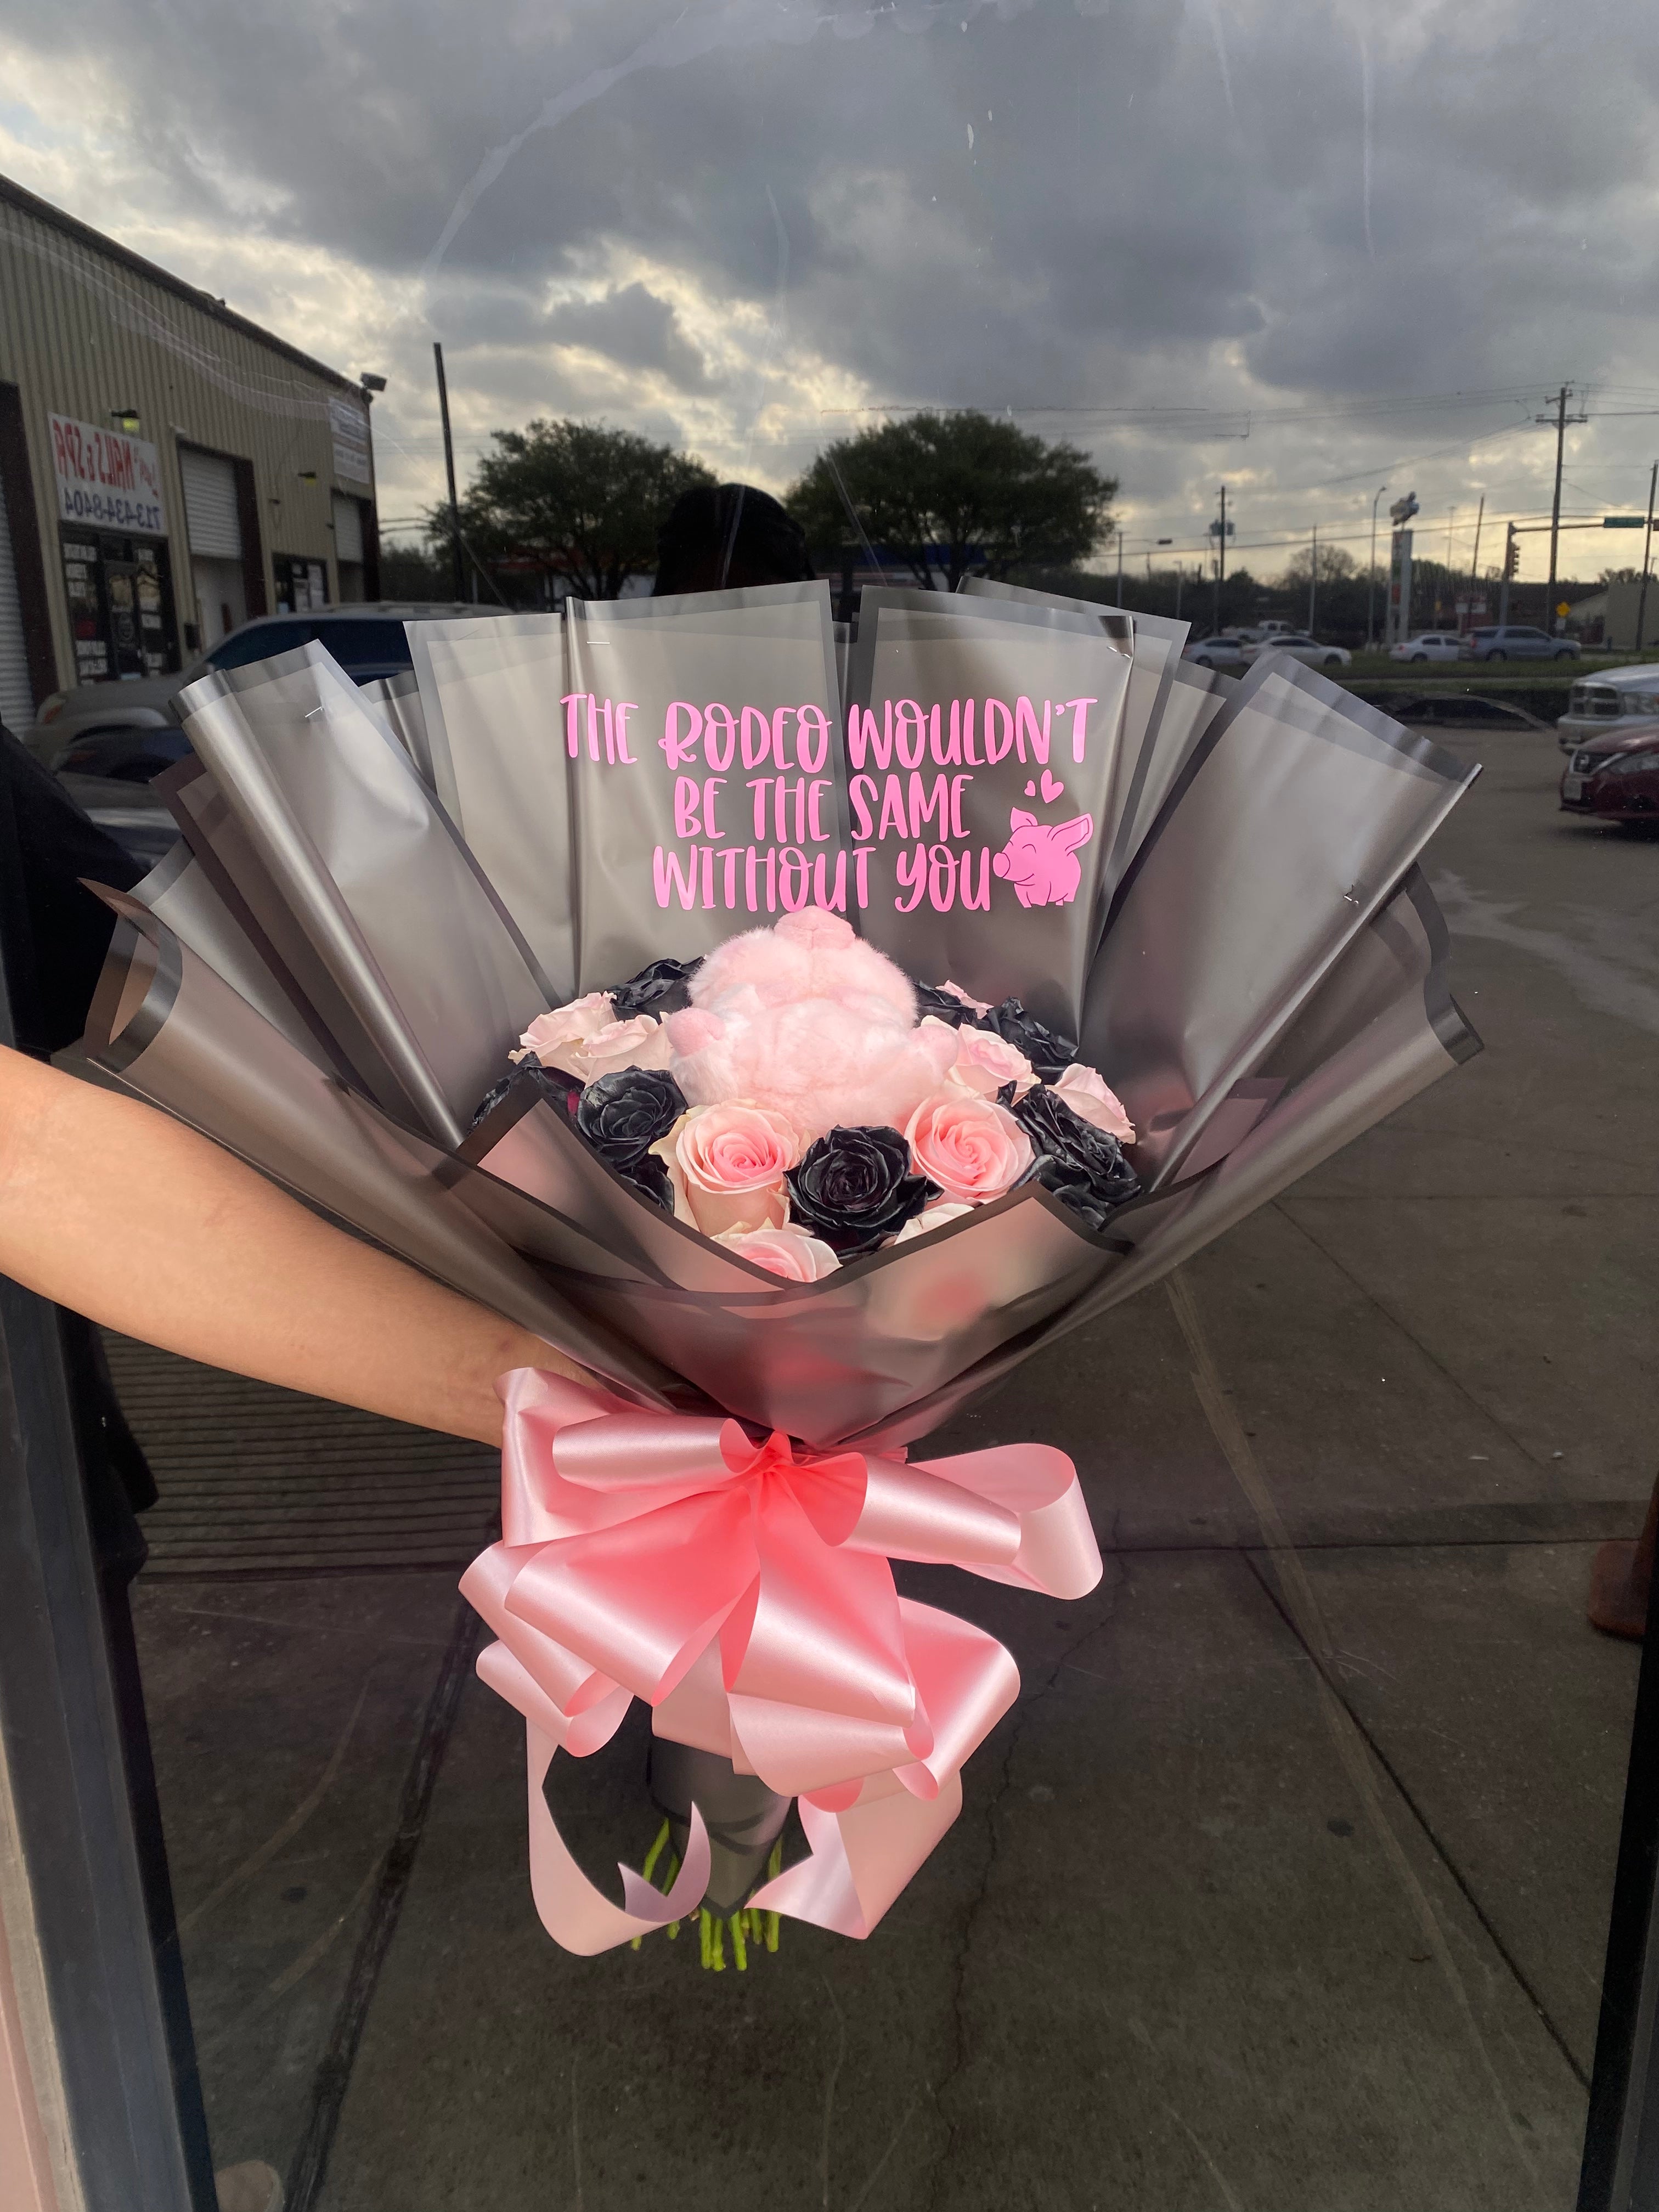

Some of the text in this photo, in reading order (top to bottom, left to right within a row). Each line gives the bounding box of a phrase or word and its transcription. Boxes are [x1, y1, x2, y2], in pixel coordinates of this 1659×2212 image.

[560, 692, 1098, 774] THE RODEO WOULDN'T
[674, 771, 974, 844] BE THE SAME
[652, 843, 990, 913] WITHOUT YOU
